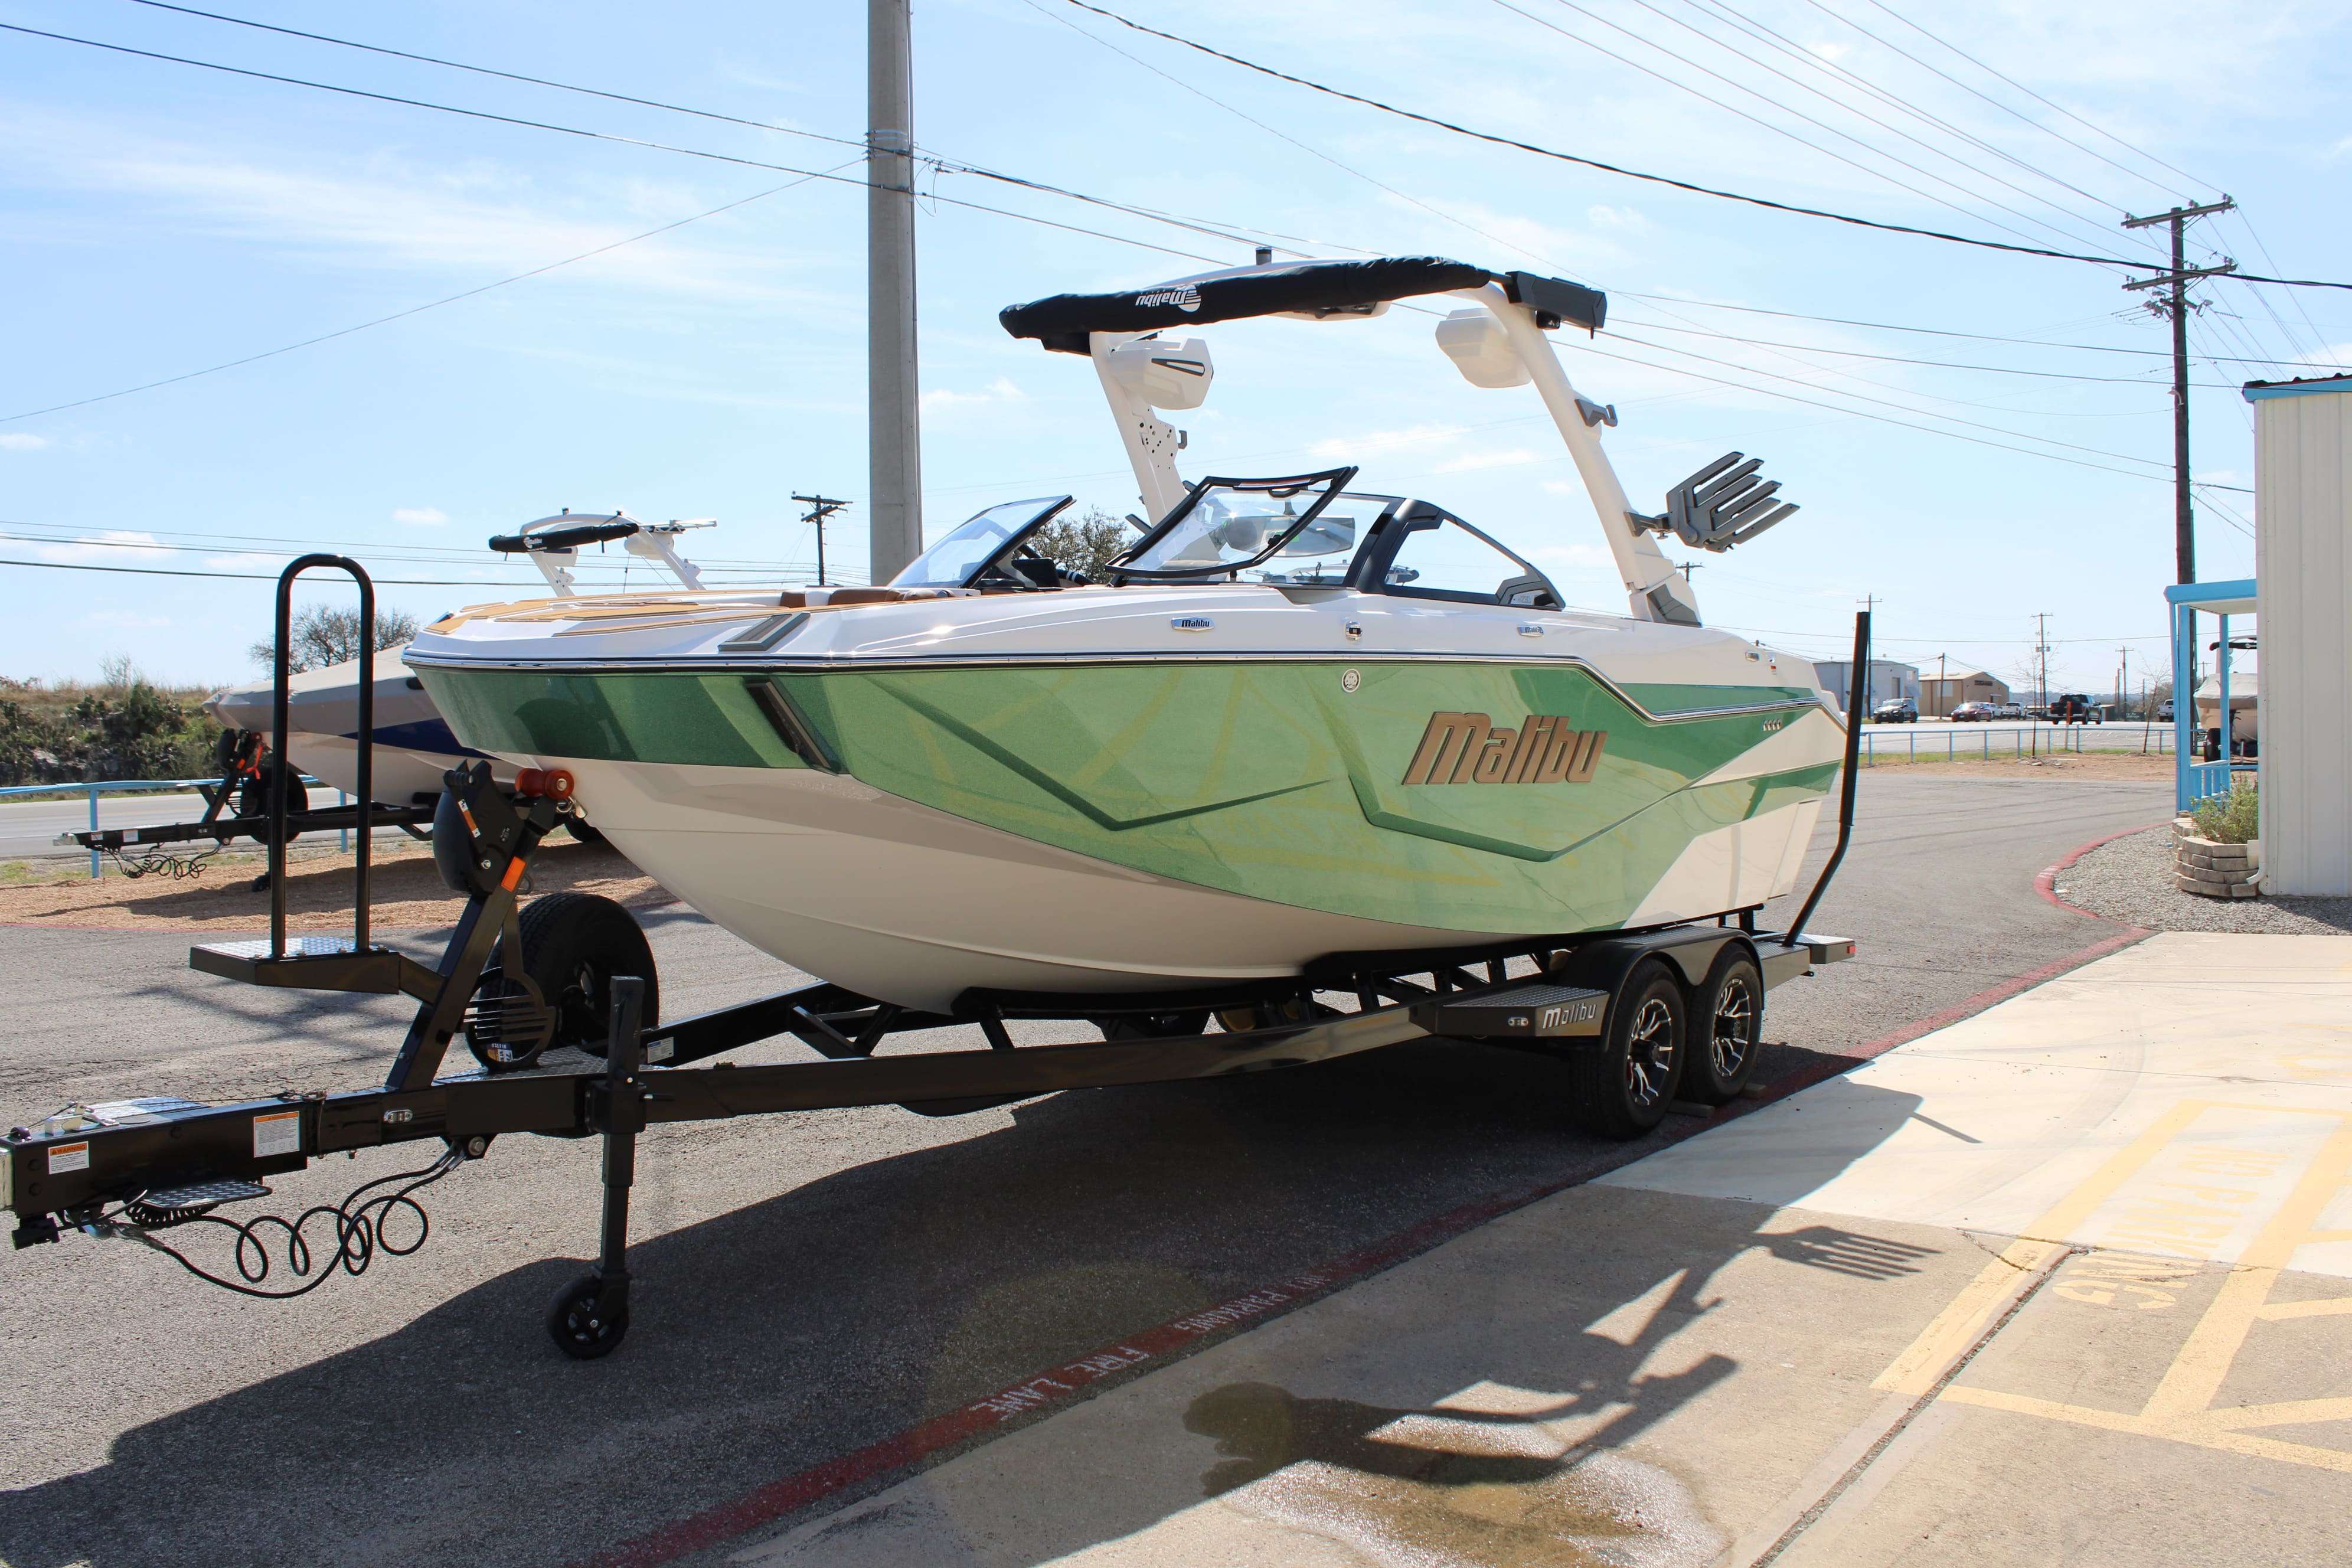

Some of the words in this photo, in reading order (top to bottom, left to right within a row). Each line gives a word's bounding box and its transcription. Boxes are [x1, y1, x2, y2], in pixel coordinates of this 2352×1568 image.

[1135, 290, 1187, 307] Malibu
[1401, 711, 1608, 785] Malibu
[1542, 1002, 1596, 1029] Malibu
[57, 1144, 86, 1154] WARNING
[1173, 1289, 1291, 1334] PARKING
[1064, 1346, 1150, 1378] FIRE
[969, 1377, 1073, 1422] LANE
